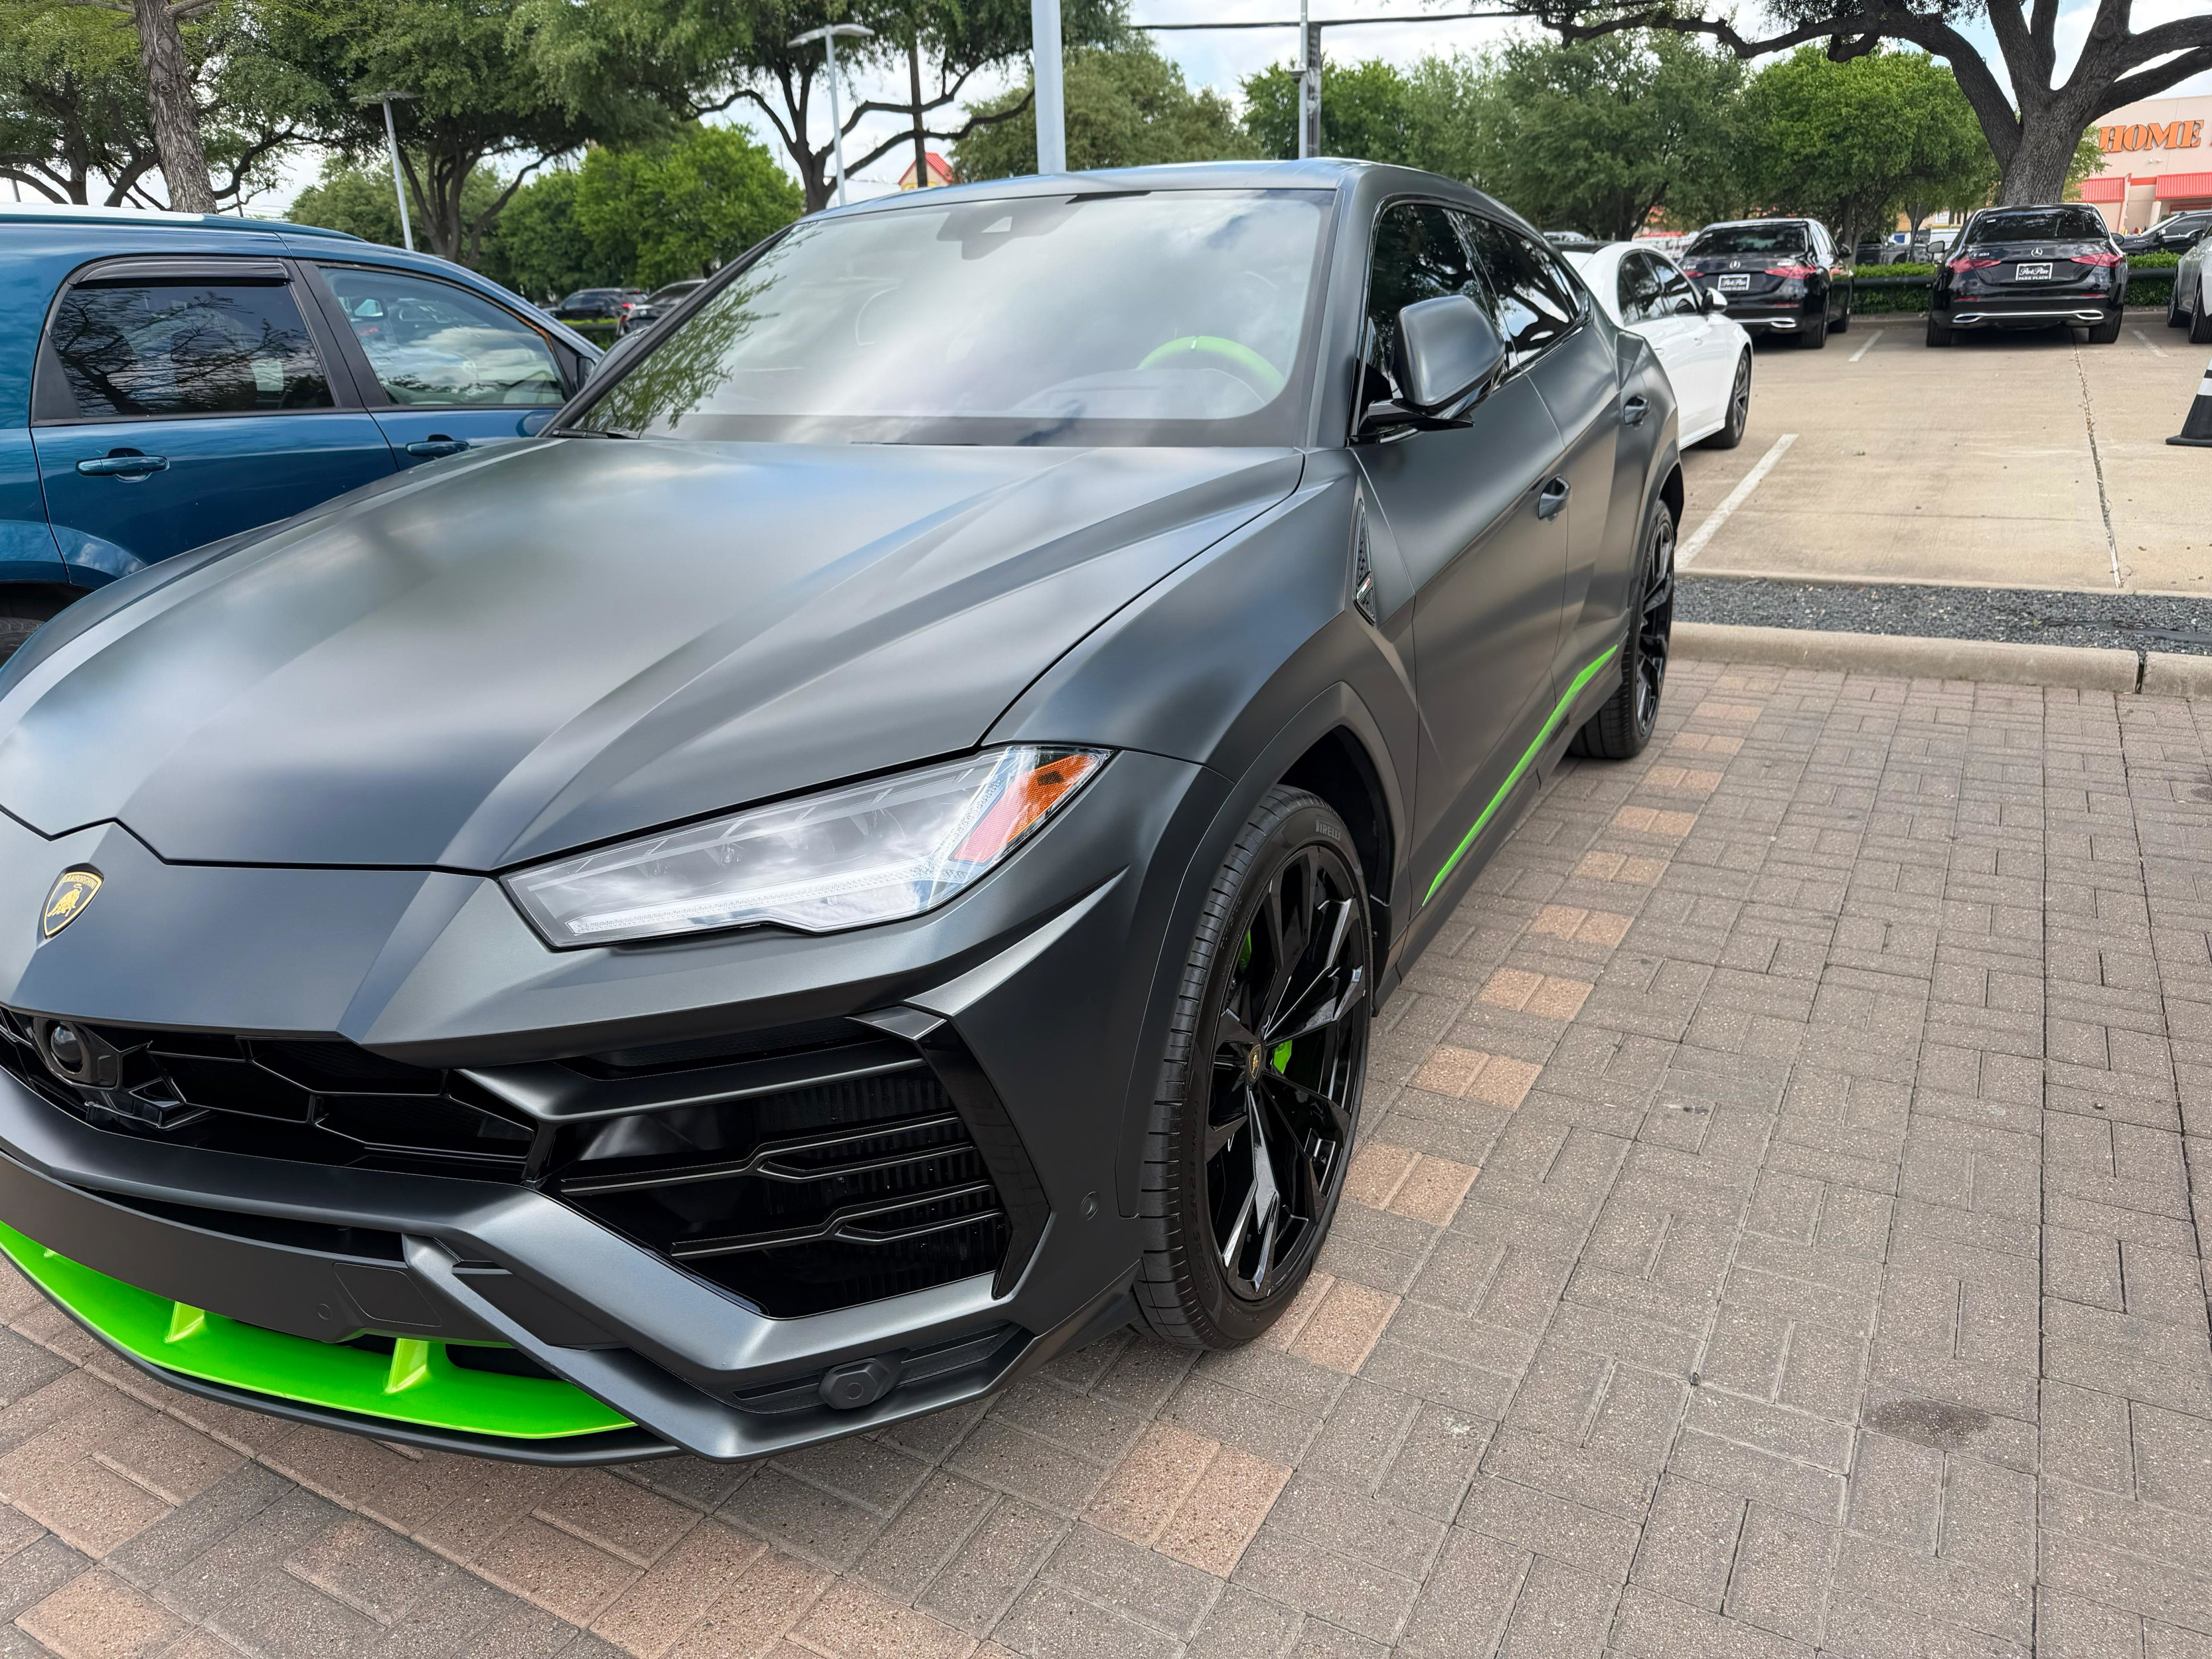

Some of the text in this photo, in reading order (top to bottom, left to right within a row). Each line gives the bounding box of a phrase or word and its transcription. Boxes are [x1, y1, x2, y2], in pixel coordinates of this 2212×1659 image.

[2099, 119, 2204, 153] HOME
[1316, 819, 1341, 841] PIRELLI
[62, 874, 98, 890] LAMBORGHINI
